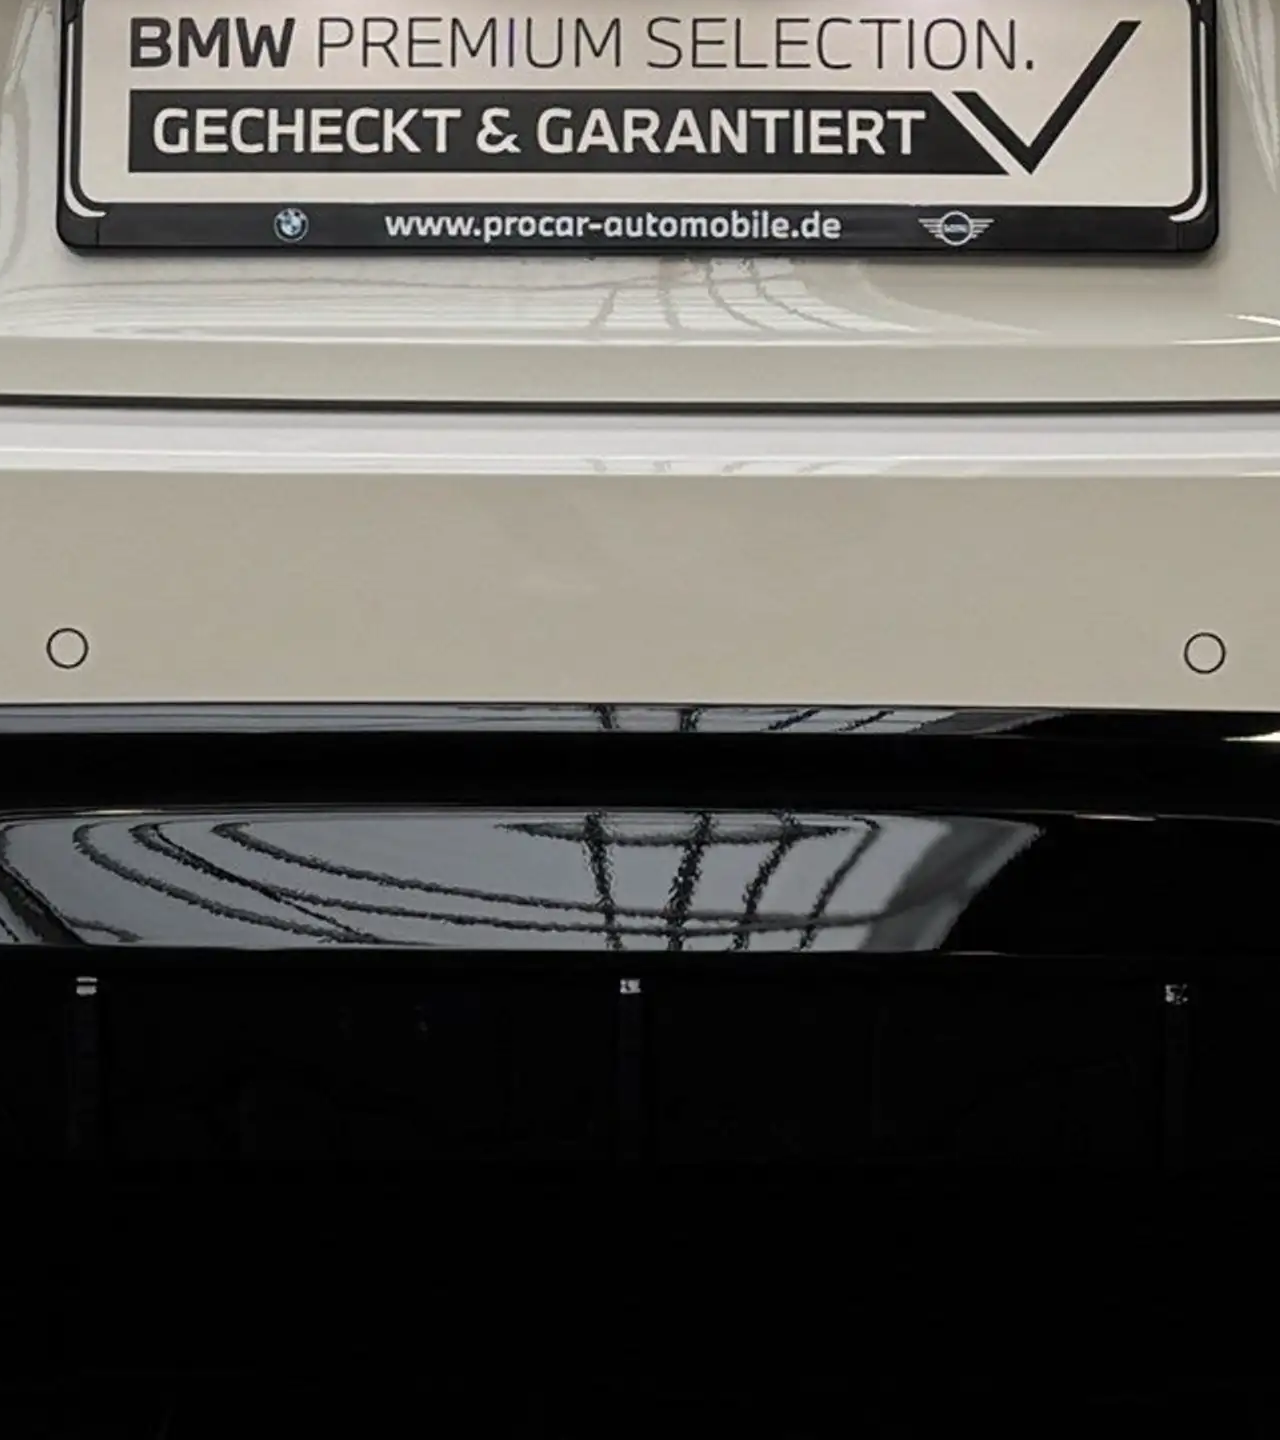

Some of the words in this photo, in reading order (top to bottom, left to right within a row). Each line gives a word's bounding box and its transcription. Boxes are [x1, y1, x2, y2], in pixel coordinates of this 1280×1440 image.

[129, 17, 296, 69] BMW
[318, 16, 621, 70] PREMIUM
[646, 16, 1035, 71] SELECTION.
[152, 107, 464, 156] GECHECKT
[473, 107, 522, 155] &
[537, 107, 926, 155] GARANTIERT
[384, 209, 843, 244] www.procar-automobile.de
